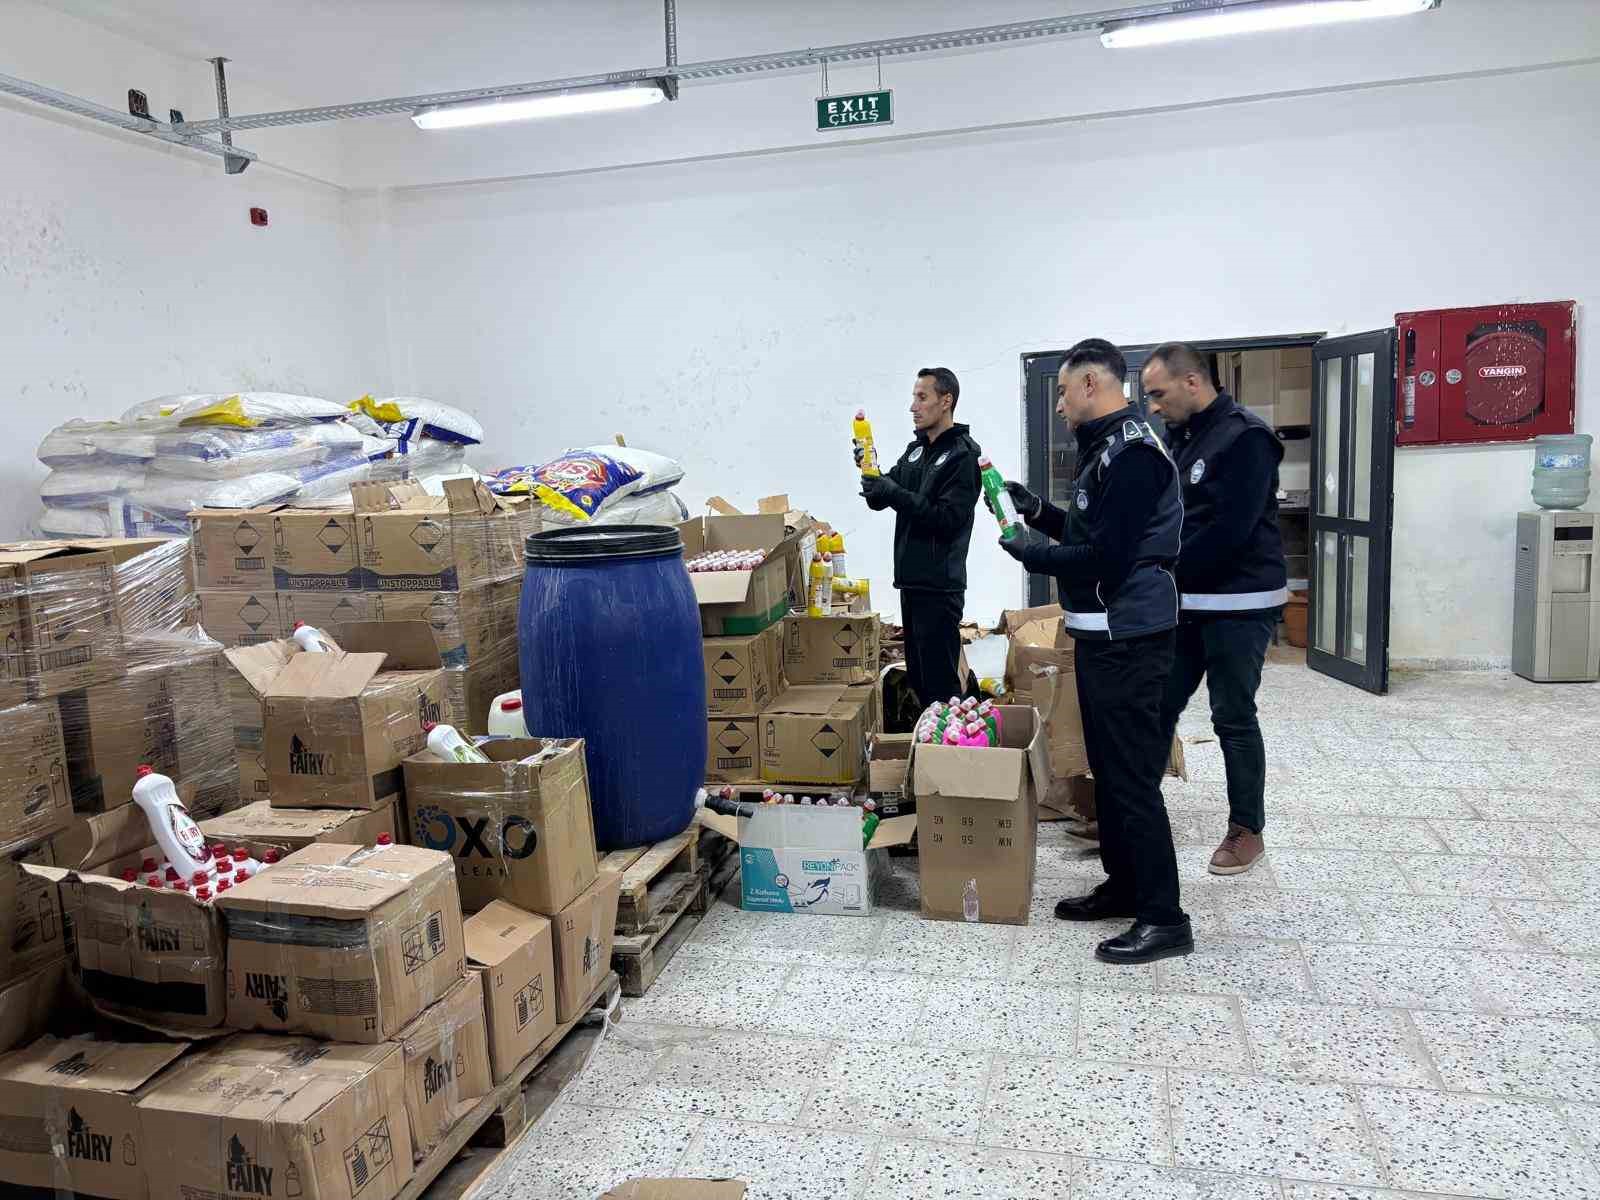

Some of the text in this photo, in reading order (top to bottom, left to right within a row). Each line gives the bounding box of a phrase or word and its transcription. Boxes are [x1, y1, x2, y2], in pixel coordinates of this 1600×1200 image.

[828, 97, 878, 114] EXIT
[829, 110, 879, 125] ÇIKIŞ
[1483, 367, 1522, 375] YANGIN
[288, 577, 348, 587] UNSTOPPABLE
[378, 577, 442, 588] UNSTOPPABLE
[419, 701, 441, 728] FAIRY
[289, 752, 324, 775] FAIRY
[417, 806, 537, 859] OXO
[138, 926, 180, 952] FAIRY
[245, 973, 288, 1001] FAIRY
[424, 1060, 452, 1104] FAIRY
[67, 1131, 112, 1162] FAIRY
[226, 1161, 273, 1196] FAIRY
